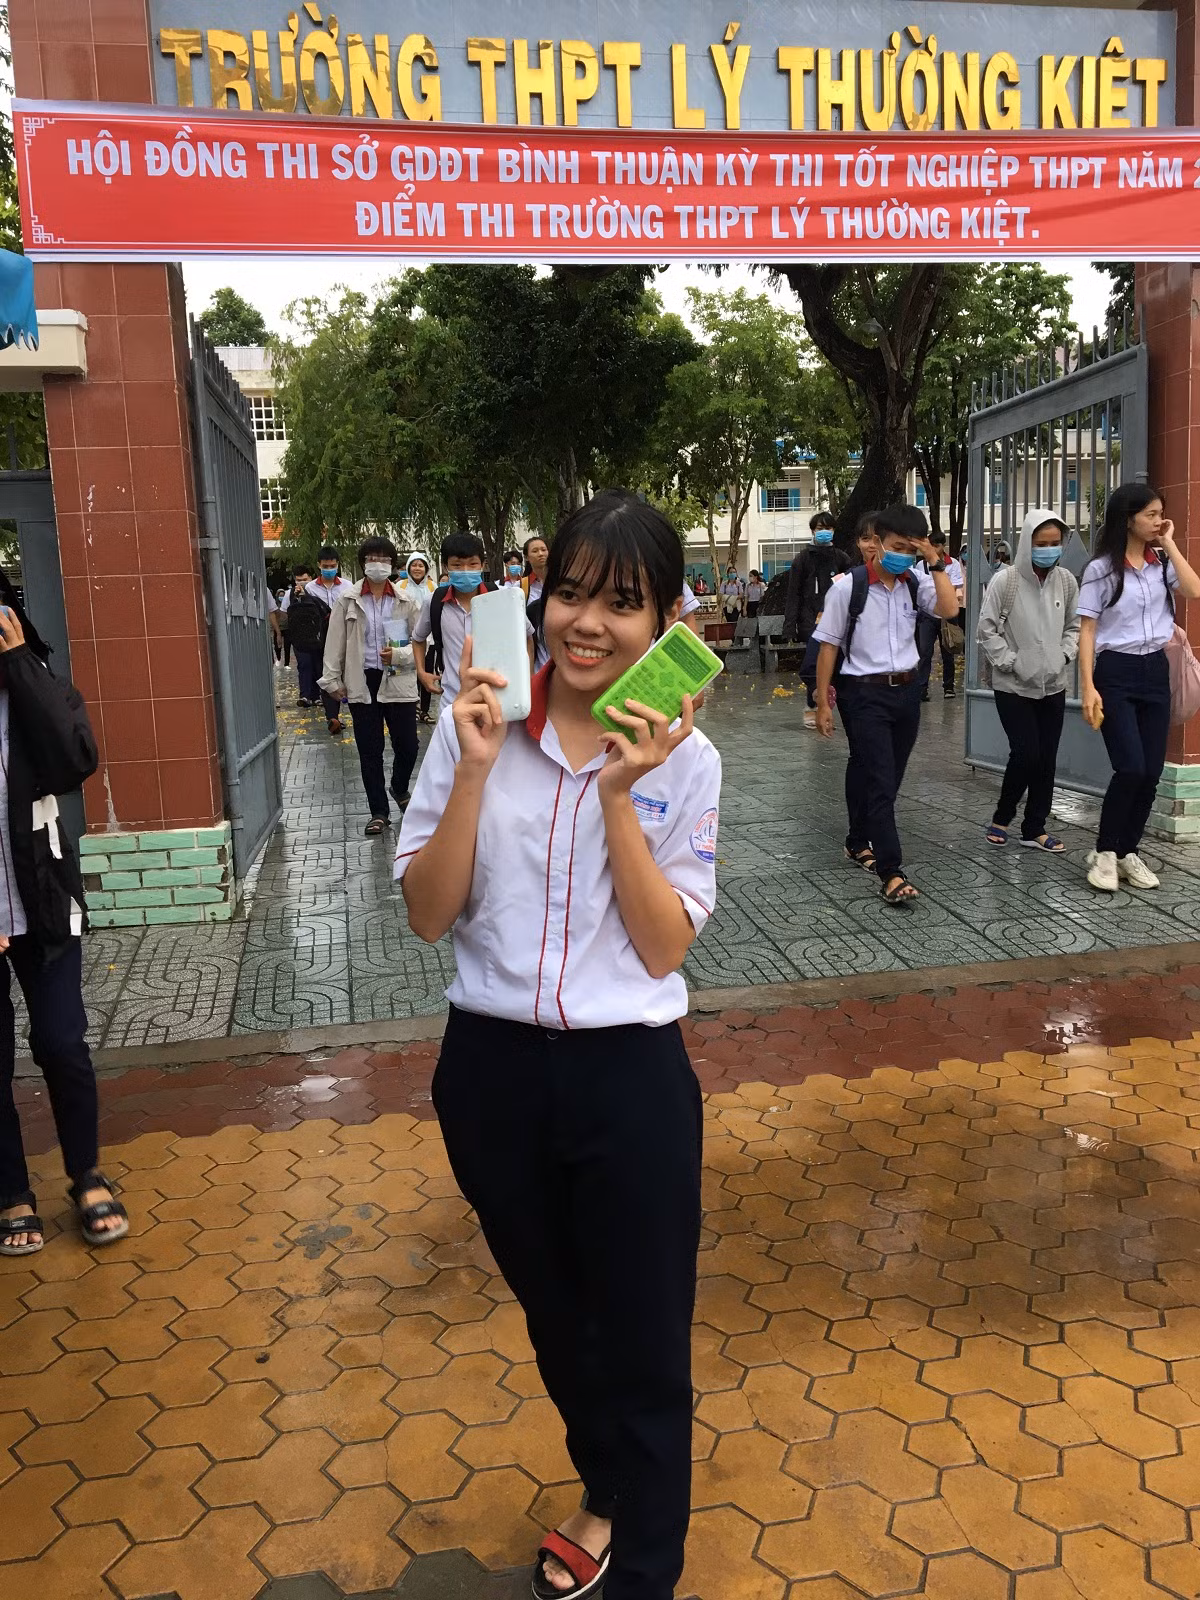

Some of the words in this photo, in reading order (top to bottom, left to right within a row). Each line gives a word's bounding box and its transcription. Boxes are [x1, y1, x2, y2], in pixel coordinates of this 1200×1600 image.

[159, 2, 442, 122] TRƯỜNG
[466, 37, 642, 128] THPT
[671, 22, 751, 130] LÝ
[777, 25, 1022, 131] THƯỜNG
[67, 130, 131, 184] HỘI
[145, 126, 247, 179] ĐỒNG
[257, 143, 318, 179] THI
[332, 133, 379, 180] SỞ
[391, 145, 484, 184] GDĐT
[498, 142, 580, 184] BÌNH
[591, 146, 703, 194] THUẬN
[716, 148, 758, 187] KỲ
[770, 154, 823, 188] THI
[834, 147, 893, 188] TỐT
[906, 147, 1018, 196] NGHIỆP
[1029, 157, 1107, 189] THPT
[1118, 150, 1183, 188] NĂM
[355, 183, 446, 237] ĐIỂM
[456, 203, 515, 238] THI
[526, 195, 665, 240] TRƯỜNG
[674, 206, 759, 239] THPT
[771, 197, 811, 239] LÝ
[821, 199, 950, 240] THƯỜNG
[961, 198, 1040, 247] KIỆT.
